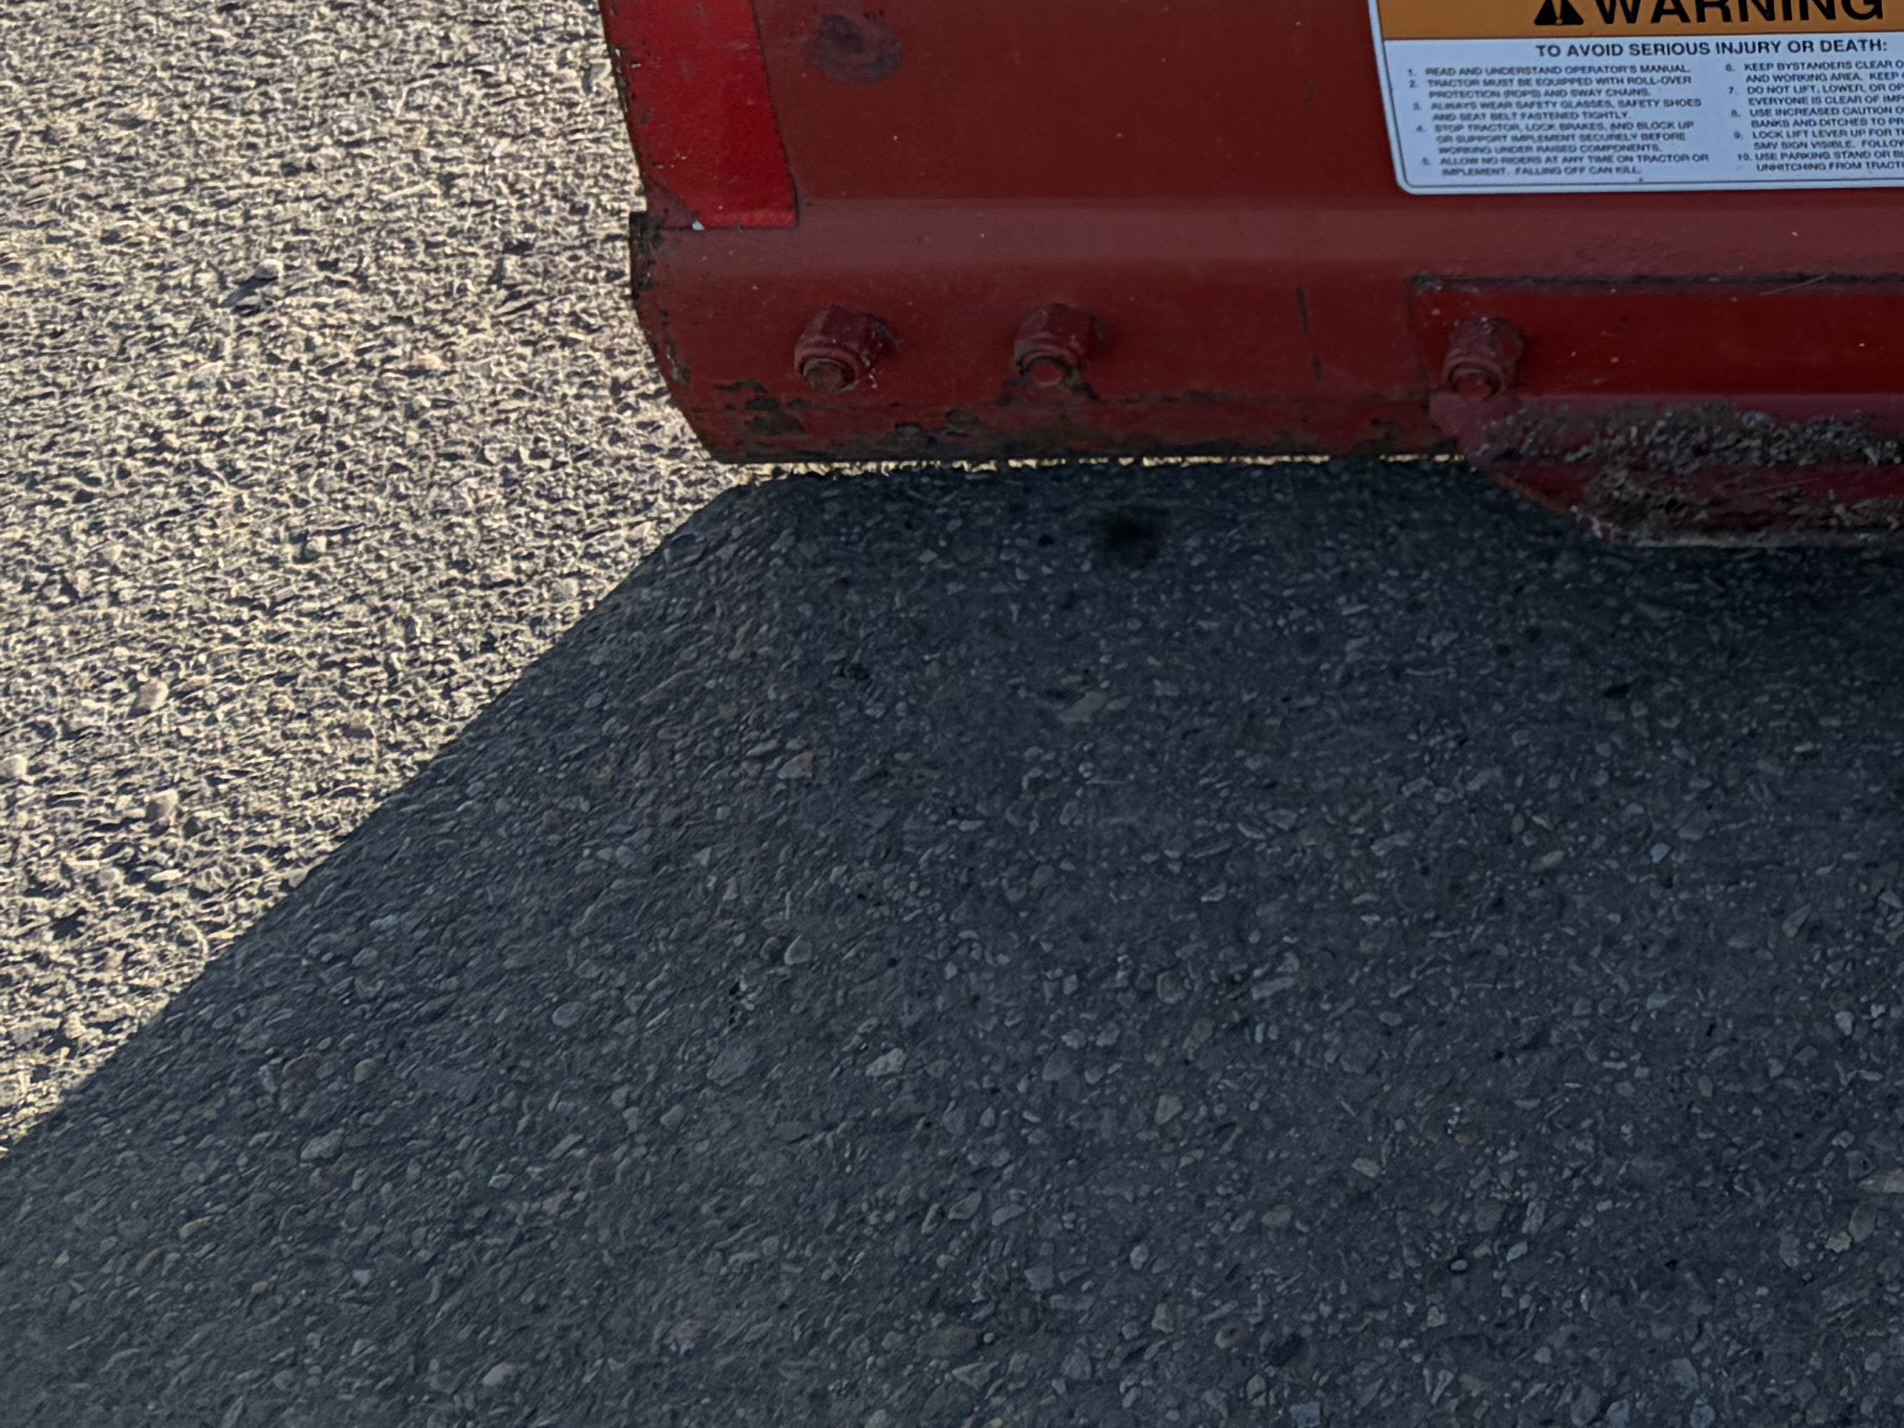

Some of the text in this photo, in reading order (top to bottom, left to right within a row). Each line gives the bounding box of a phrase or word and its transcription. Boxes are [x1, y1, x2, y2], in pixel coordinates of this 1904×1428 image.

[1536, 38, 1886, 57] TO AVOID SERIOUS INJURY OR DEATH:
